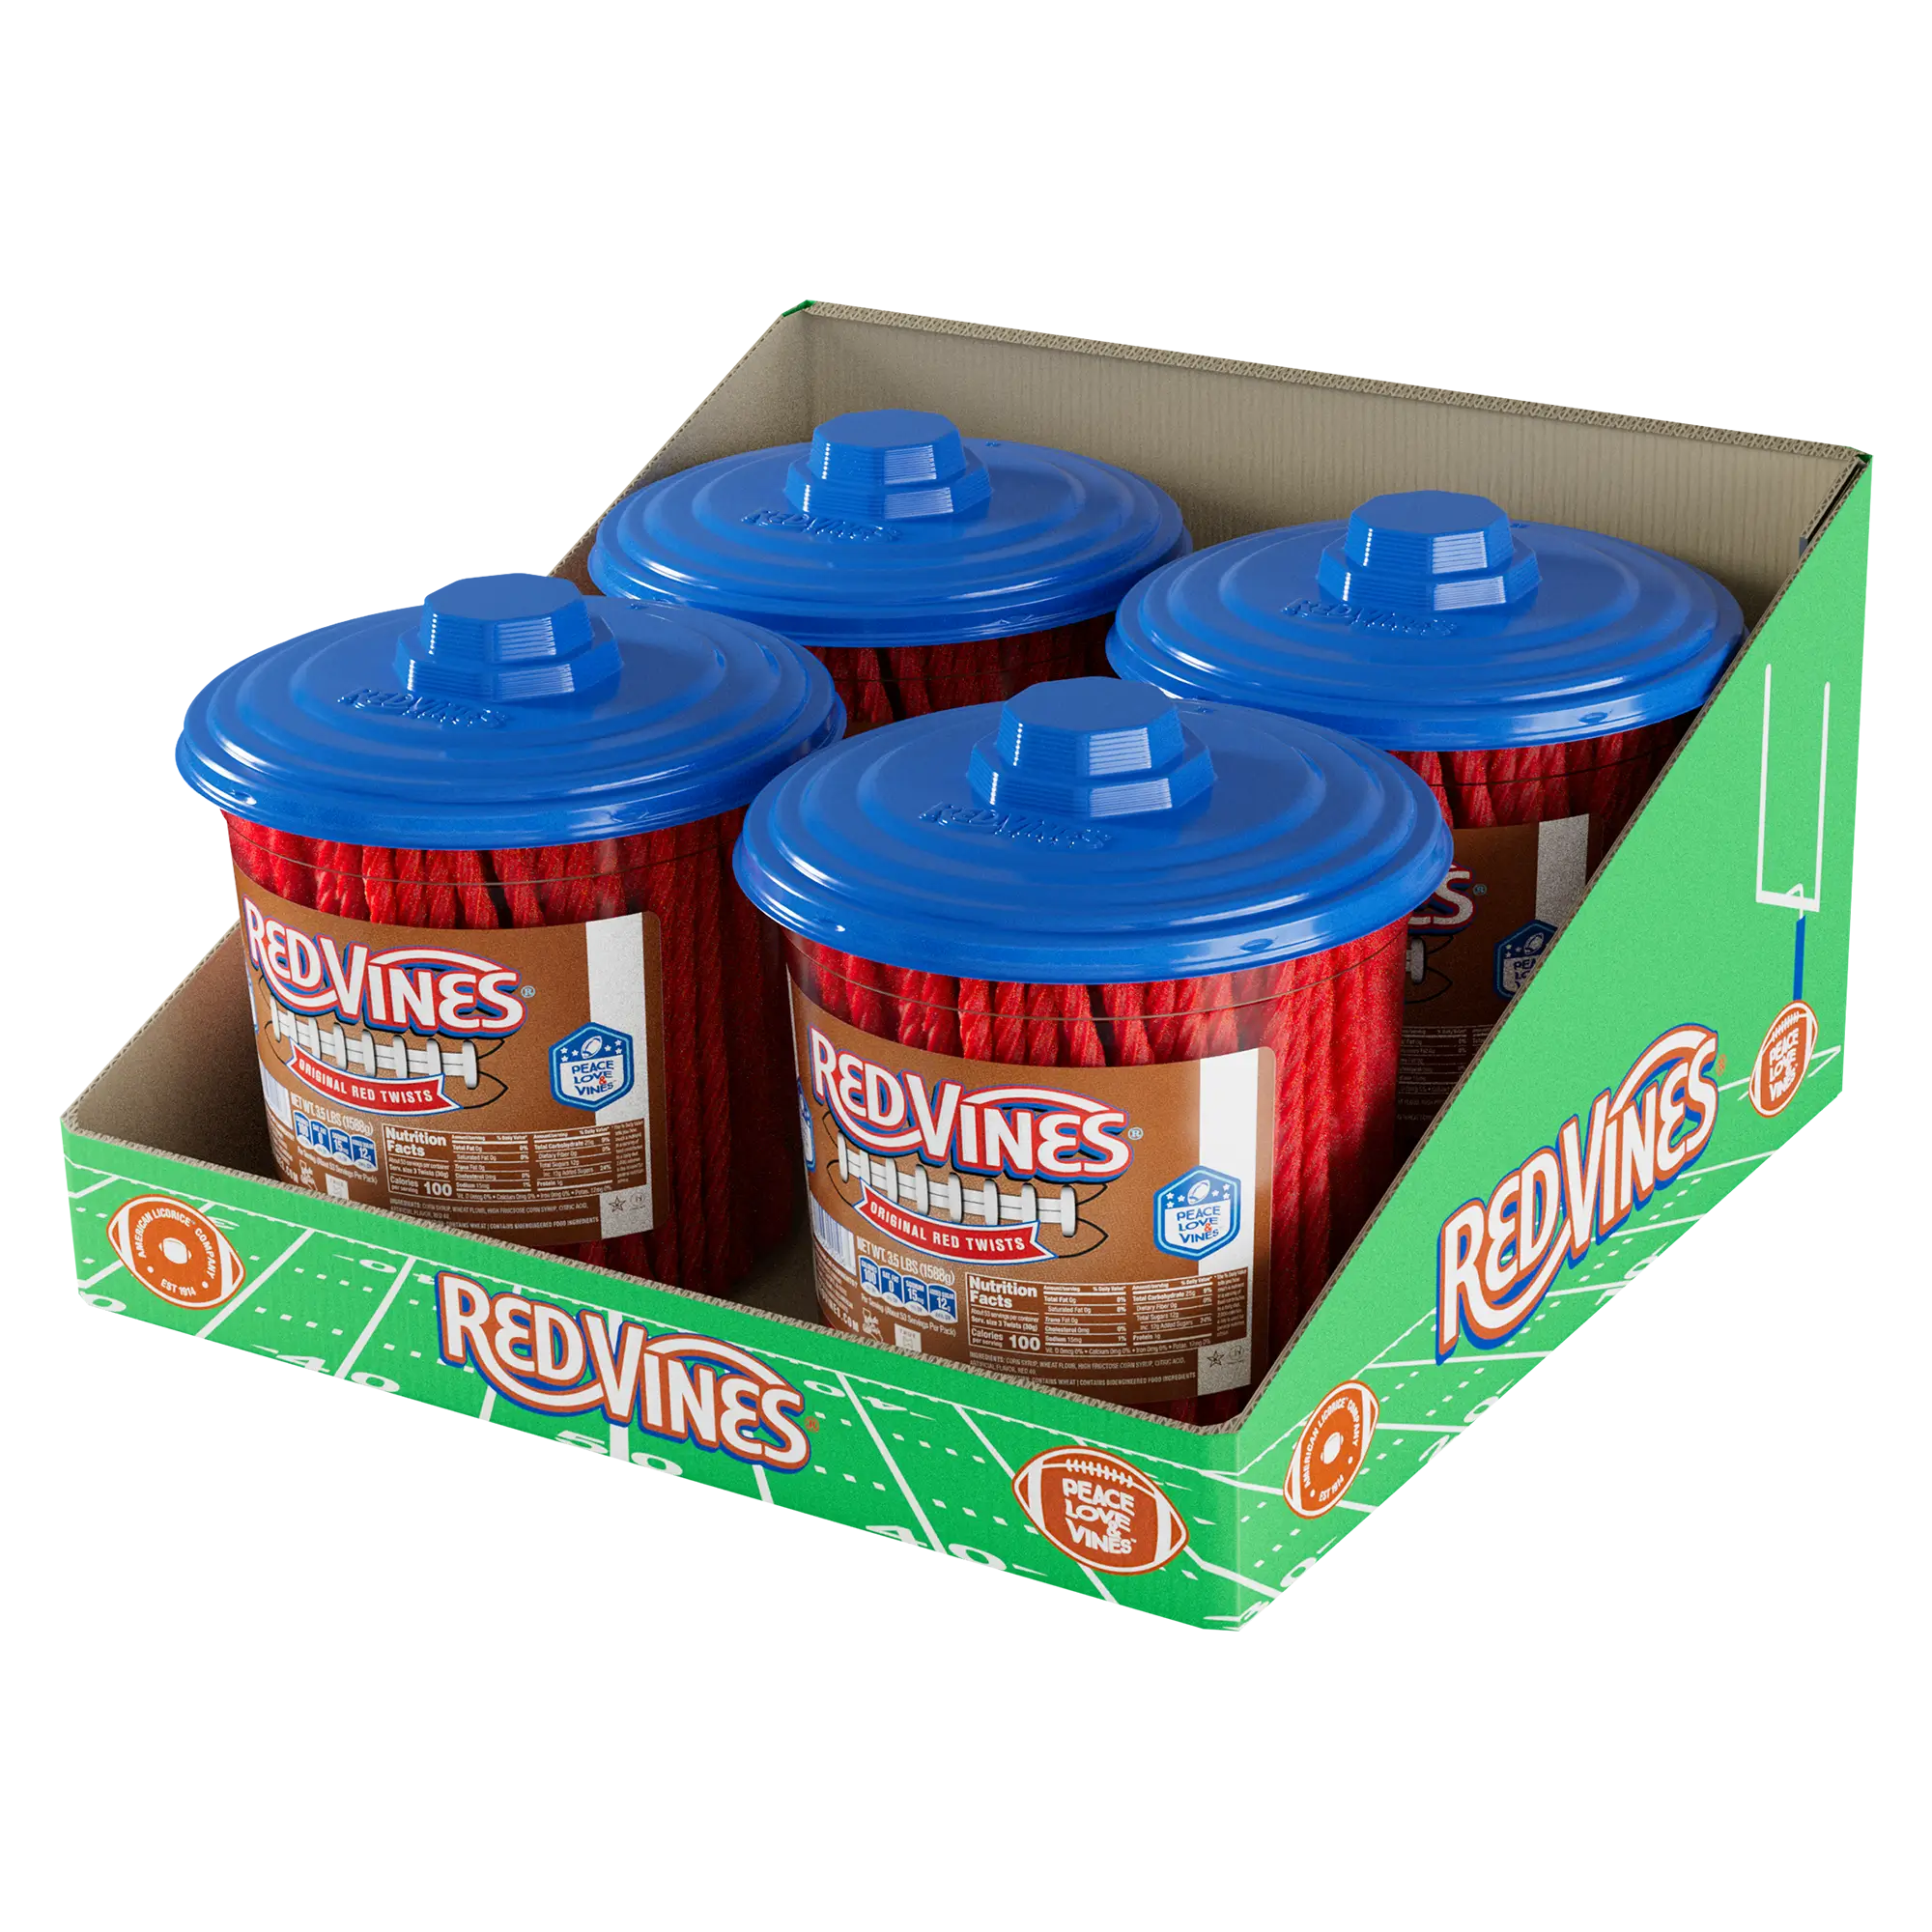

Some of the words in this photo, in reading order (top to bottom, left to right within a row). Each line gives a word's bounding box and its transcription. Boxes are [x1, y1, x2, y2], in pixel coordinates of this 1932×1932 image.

[1770, 1028, 1799, 1065] PEACE
[572, 1061, 614, 1074] PEACE
[1770, 1048, 1796, 1083] LOVE
[298, 1059, 346, 1094] ORIGINAL
[352, 1087, 375, 1101] RED
[381, 1090, 433, 1103] TWISTS
[574, 1070, 612, 1084] LOVE
[574, 1082, 613, 1095] VINES
[1769, 1072, 1796, 1101] VINES
[385, 1127, 446, 1147] Nutrition
[386, 1140, 425, 1156] Facts
[390, 1176, 418, 1187] Calories
[424, 1181, 452, 1196] 100
[1177, 1206, 1220, 1221] PEACE
[869, 1202, 926, 1241] ORIGINAL
[933, 1231, 960, 1249] RED
[966, 1236, 1025, 1252] TWISTS
[1179, 1217, 1218, 1232] LOVE
[1205, 1223, 1211, 1232] &
[134, 1211, 153, 1258] AMERICAN
[154, 1208, 190, 1227] LICORICE
[195, 1228, 216, 1280] COMPANY
[1179, 1229, 1219, 1243] VINES
[857, 1237, 869, 1254] NET
[900, 1256, 918, 1274] LBS
[920, 1263, 954, 1286] (1588g)
[160, 1279, 177, 1293] EST
[179, 1286, 197, 1296] 1914
[969, 1276, 1037, 1297] Nutrition
[970, 1290, 1012, 1308] Facts
[1148, 1292, 1184, 1300] Carbohydrate
[1004, 1321, 1021, 1329] Twists
[972, 1328, 1004, 1341] Calories
[1009, 1335, 1040, 1350] 100
[982, 1339, 1003, 1348] serving
[1303, 1428, 1319, 1489] AMERICAN
[1318, 1397, 1346, 1428] LICORICE
[1348, 1399, 1360, 1446] COMPANY
[1319, 1489, 1329, 1502] EST
[1331, 1474, 1344, 1493] 1914
[1063, 1478, 1135, 1517] PEACE
[1065, 1498, 1130, 1532] LOVE
[1065, 1517, 1132, 1554] VINES
[1107, 1520, 1122, 1538] &
